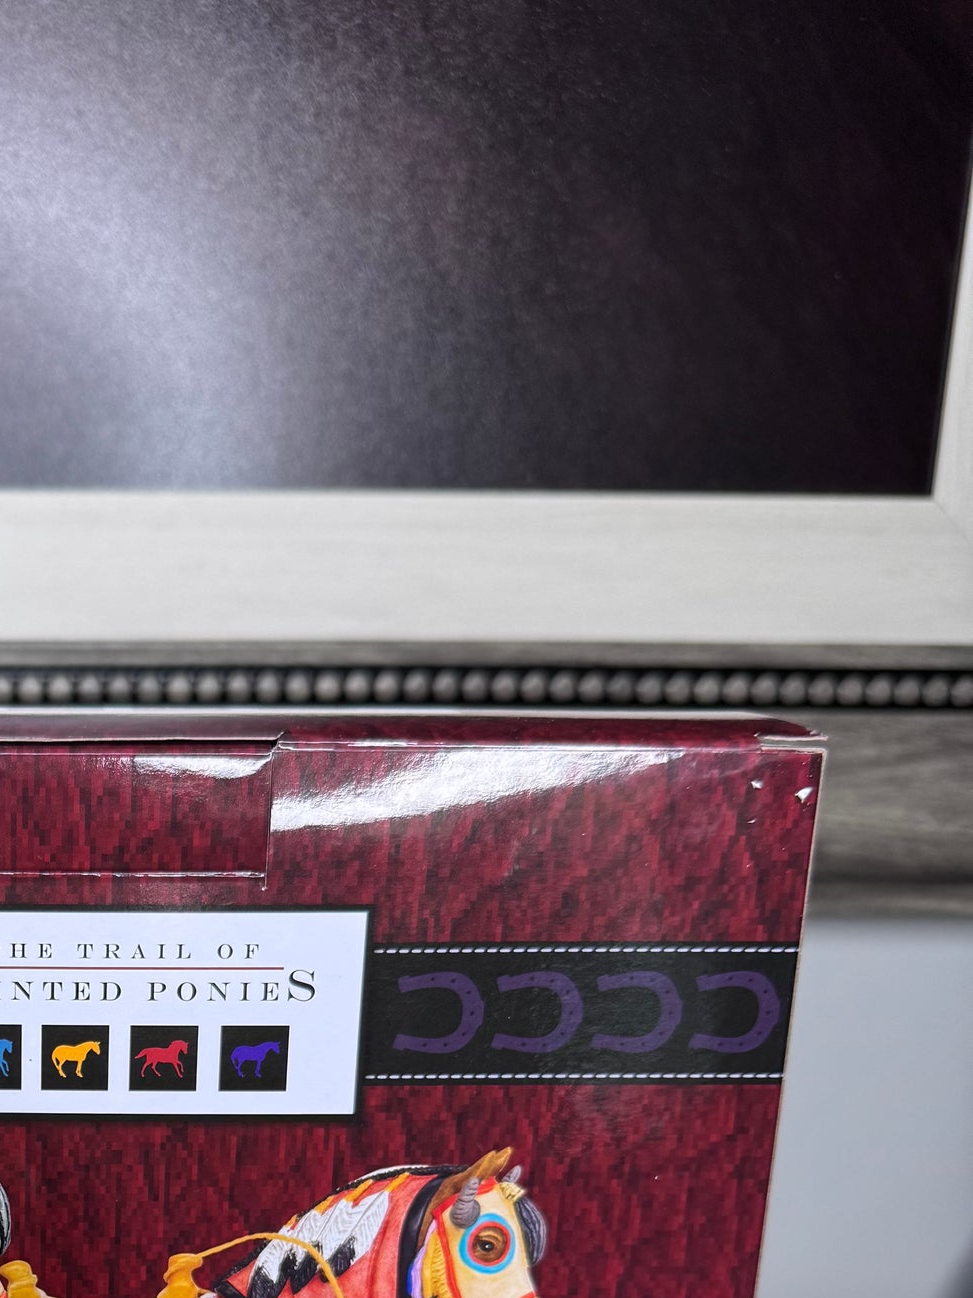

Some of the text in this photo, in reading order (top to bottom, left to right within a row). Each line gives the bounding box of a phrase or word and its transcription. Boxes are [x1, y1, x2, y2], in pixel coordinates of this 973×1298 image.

[77, 942, 192, 960] TRAIL
[217, 943, 261, 960] OF
[147, 969, 316, 1003] PONIES
